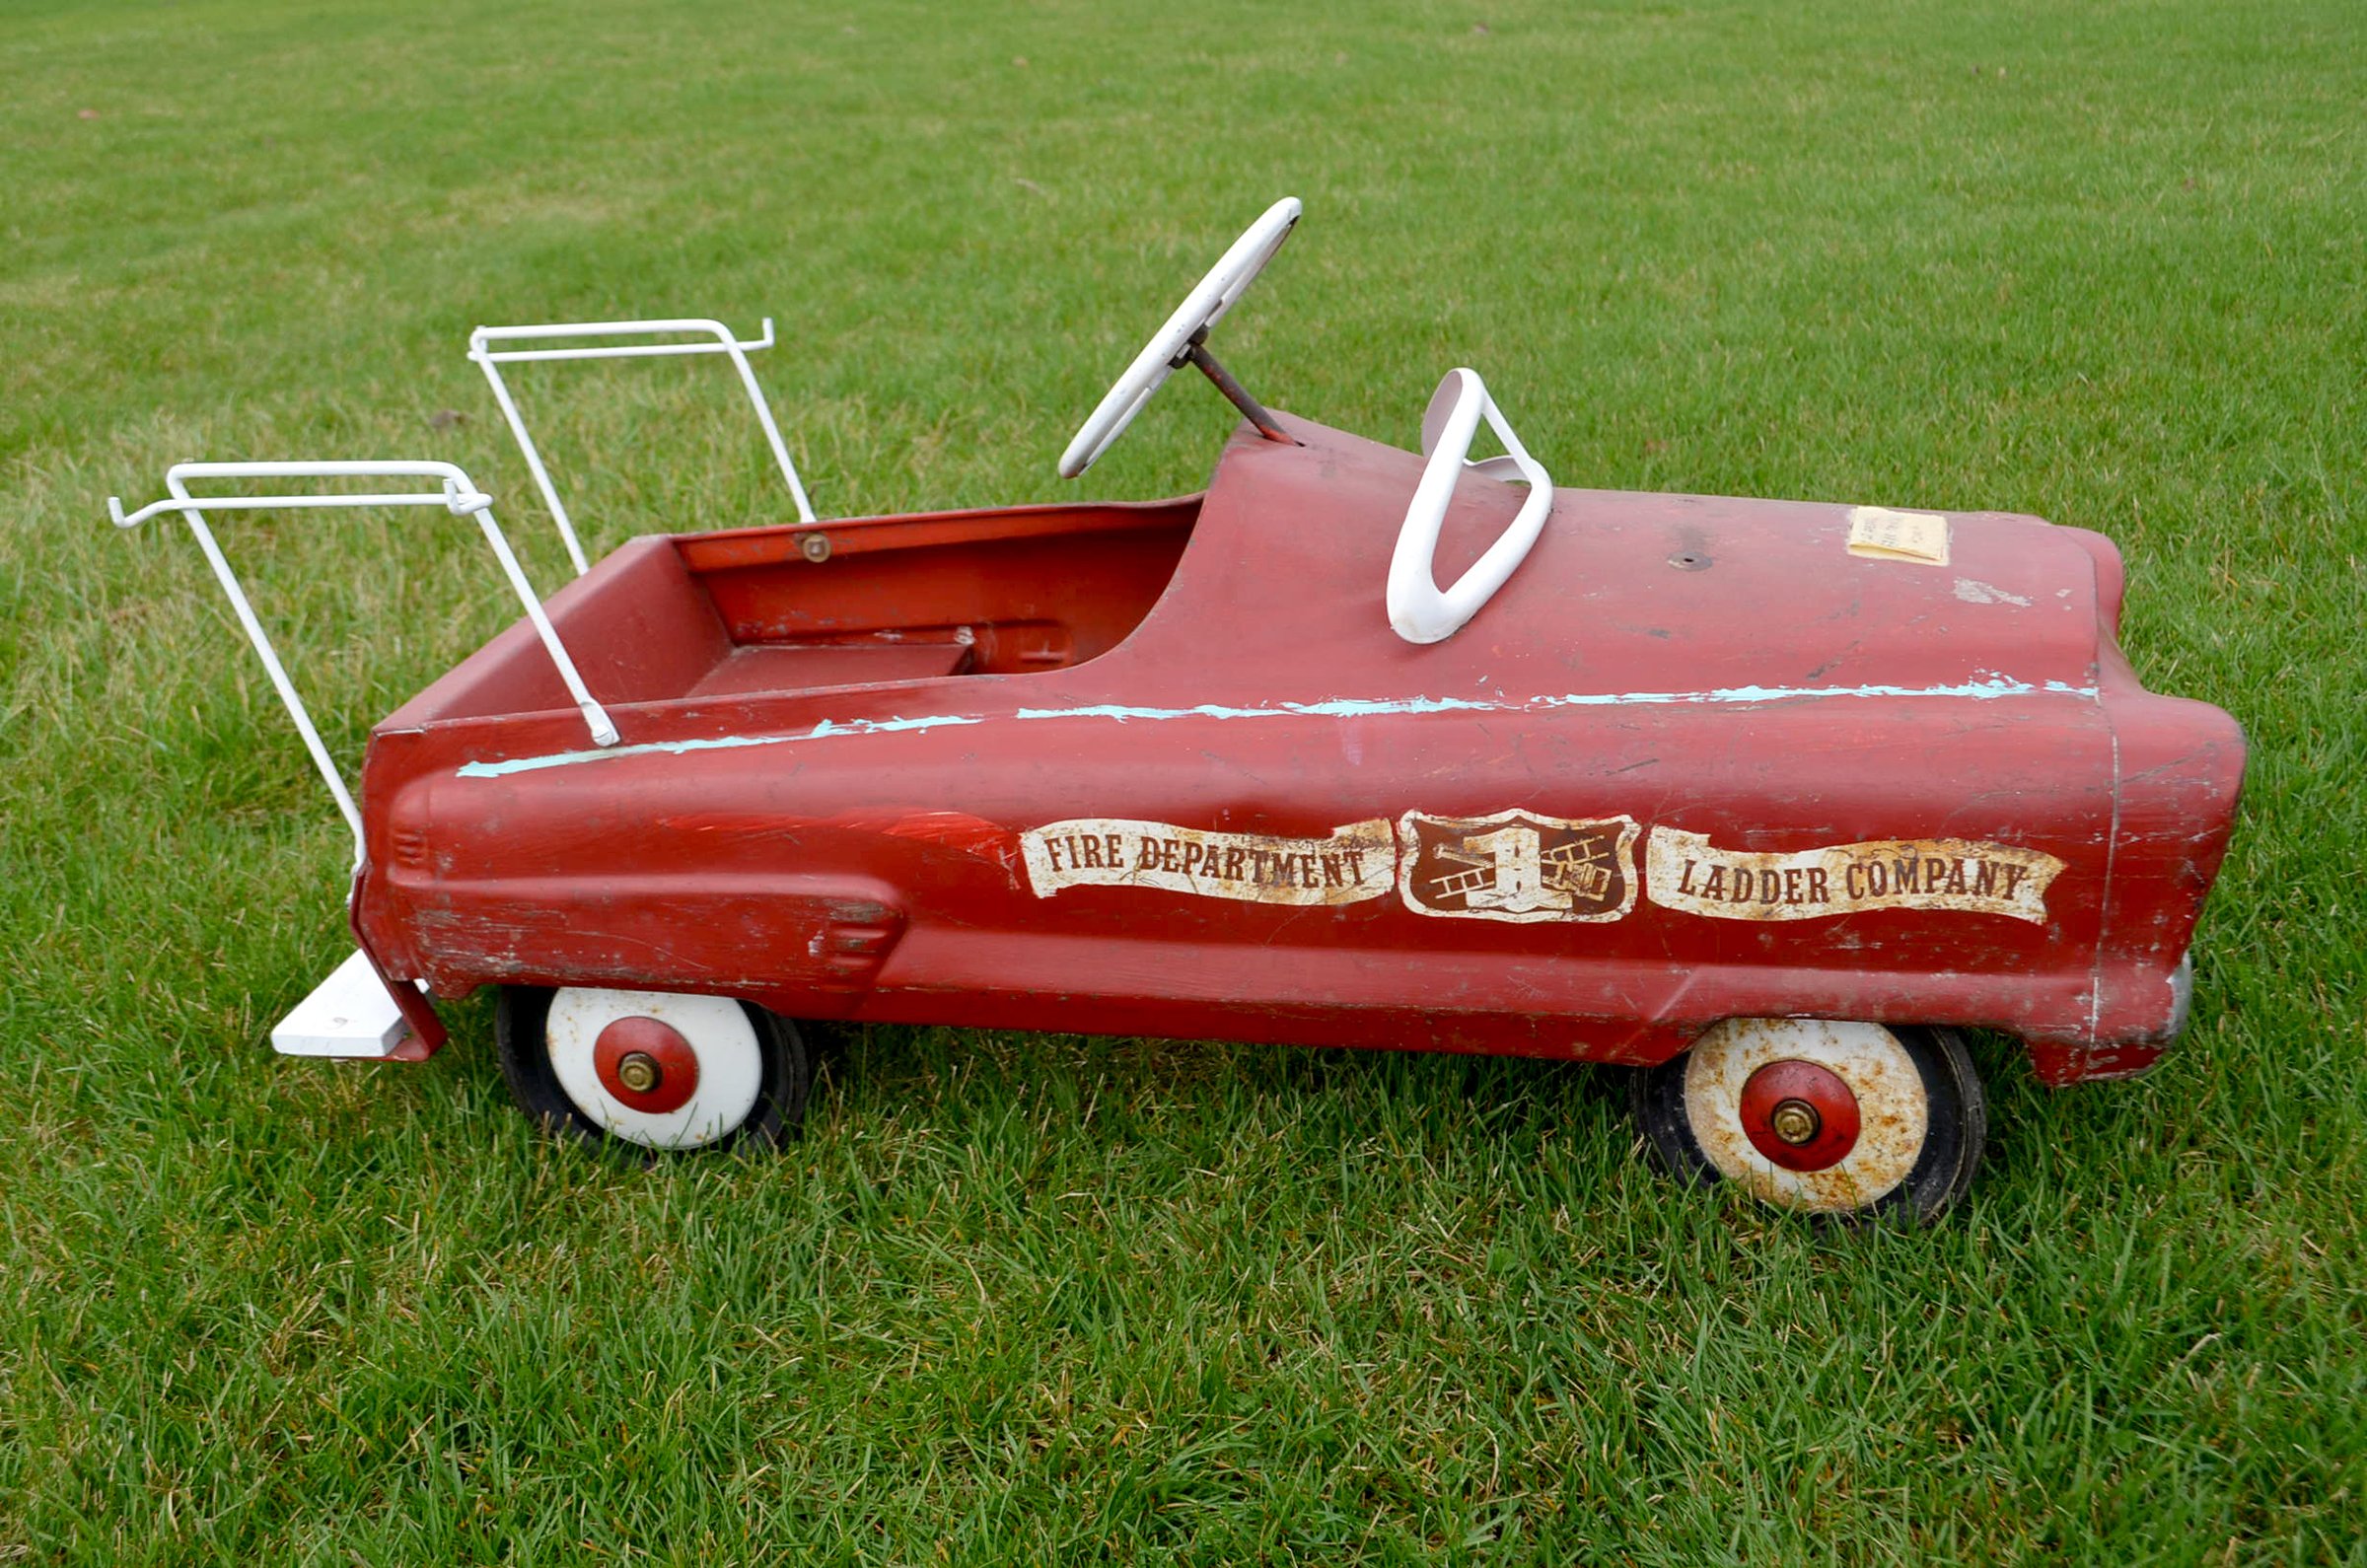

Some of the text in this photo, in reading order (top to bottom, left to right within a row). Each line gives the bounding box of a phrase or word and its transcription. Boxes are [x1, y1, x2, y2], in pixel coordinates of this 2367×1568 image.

[1044, 834, 1365, 889] FIRE DEPARTMENT
[1678, 858, 2028, 904] LADDER COMPANY
